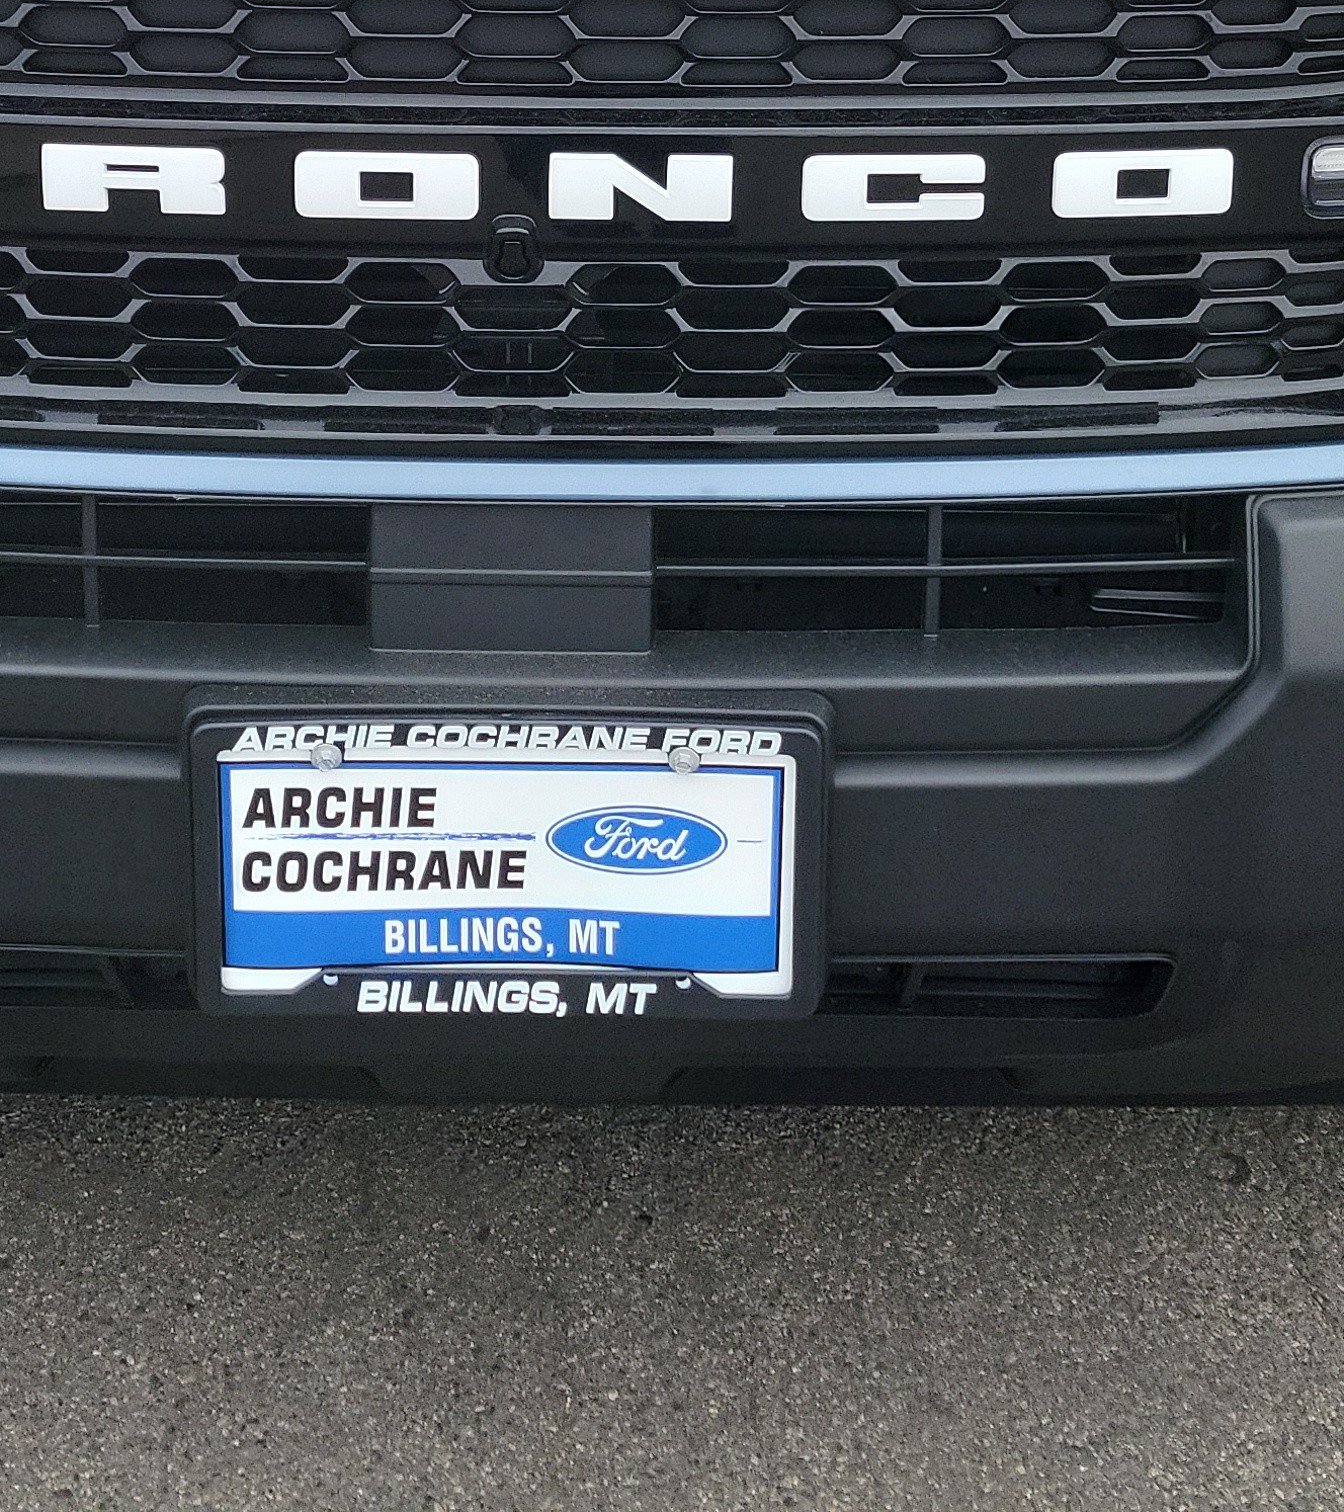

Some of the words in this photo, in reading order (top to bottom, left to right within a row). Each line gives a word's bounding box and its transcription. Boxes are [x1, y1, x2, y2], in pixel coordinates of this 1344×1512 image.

[231, 723, 395, 752] ARCHIE
[405, 724, 651, 751] COCHRANE
[661, 728, 782, 756] FORD
[241, 786, 437, 830] ARCHIE
[584, 814, 689, 862] Ford
[240, 848, 527, 894] COCHRANE
[384, 917, 554, 958] BILLINGS,
[568, 918, 621, 955] MT
[356, 980, 568, 1018] BILLINGS,
[584, 982, 658, 1016] MT
